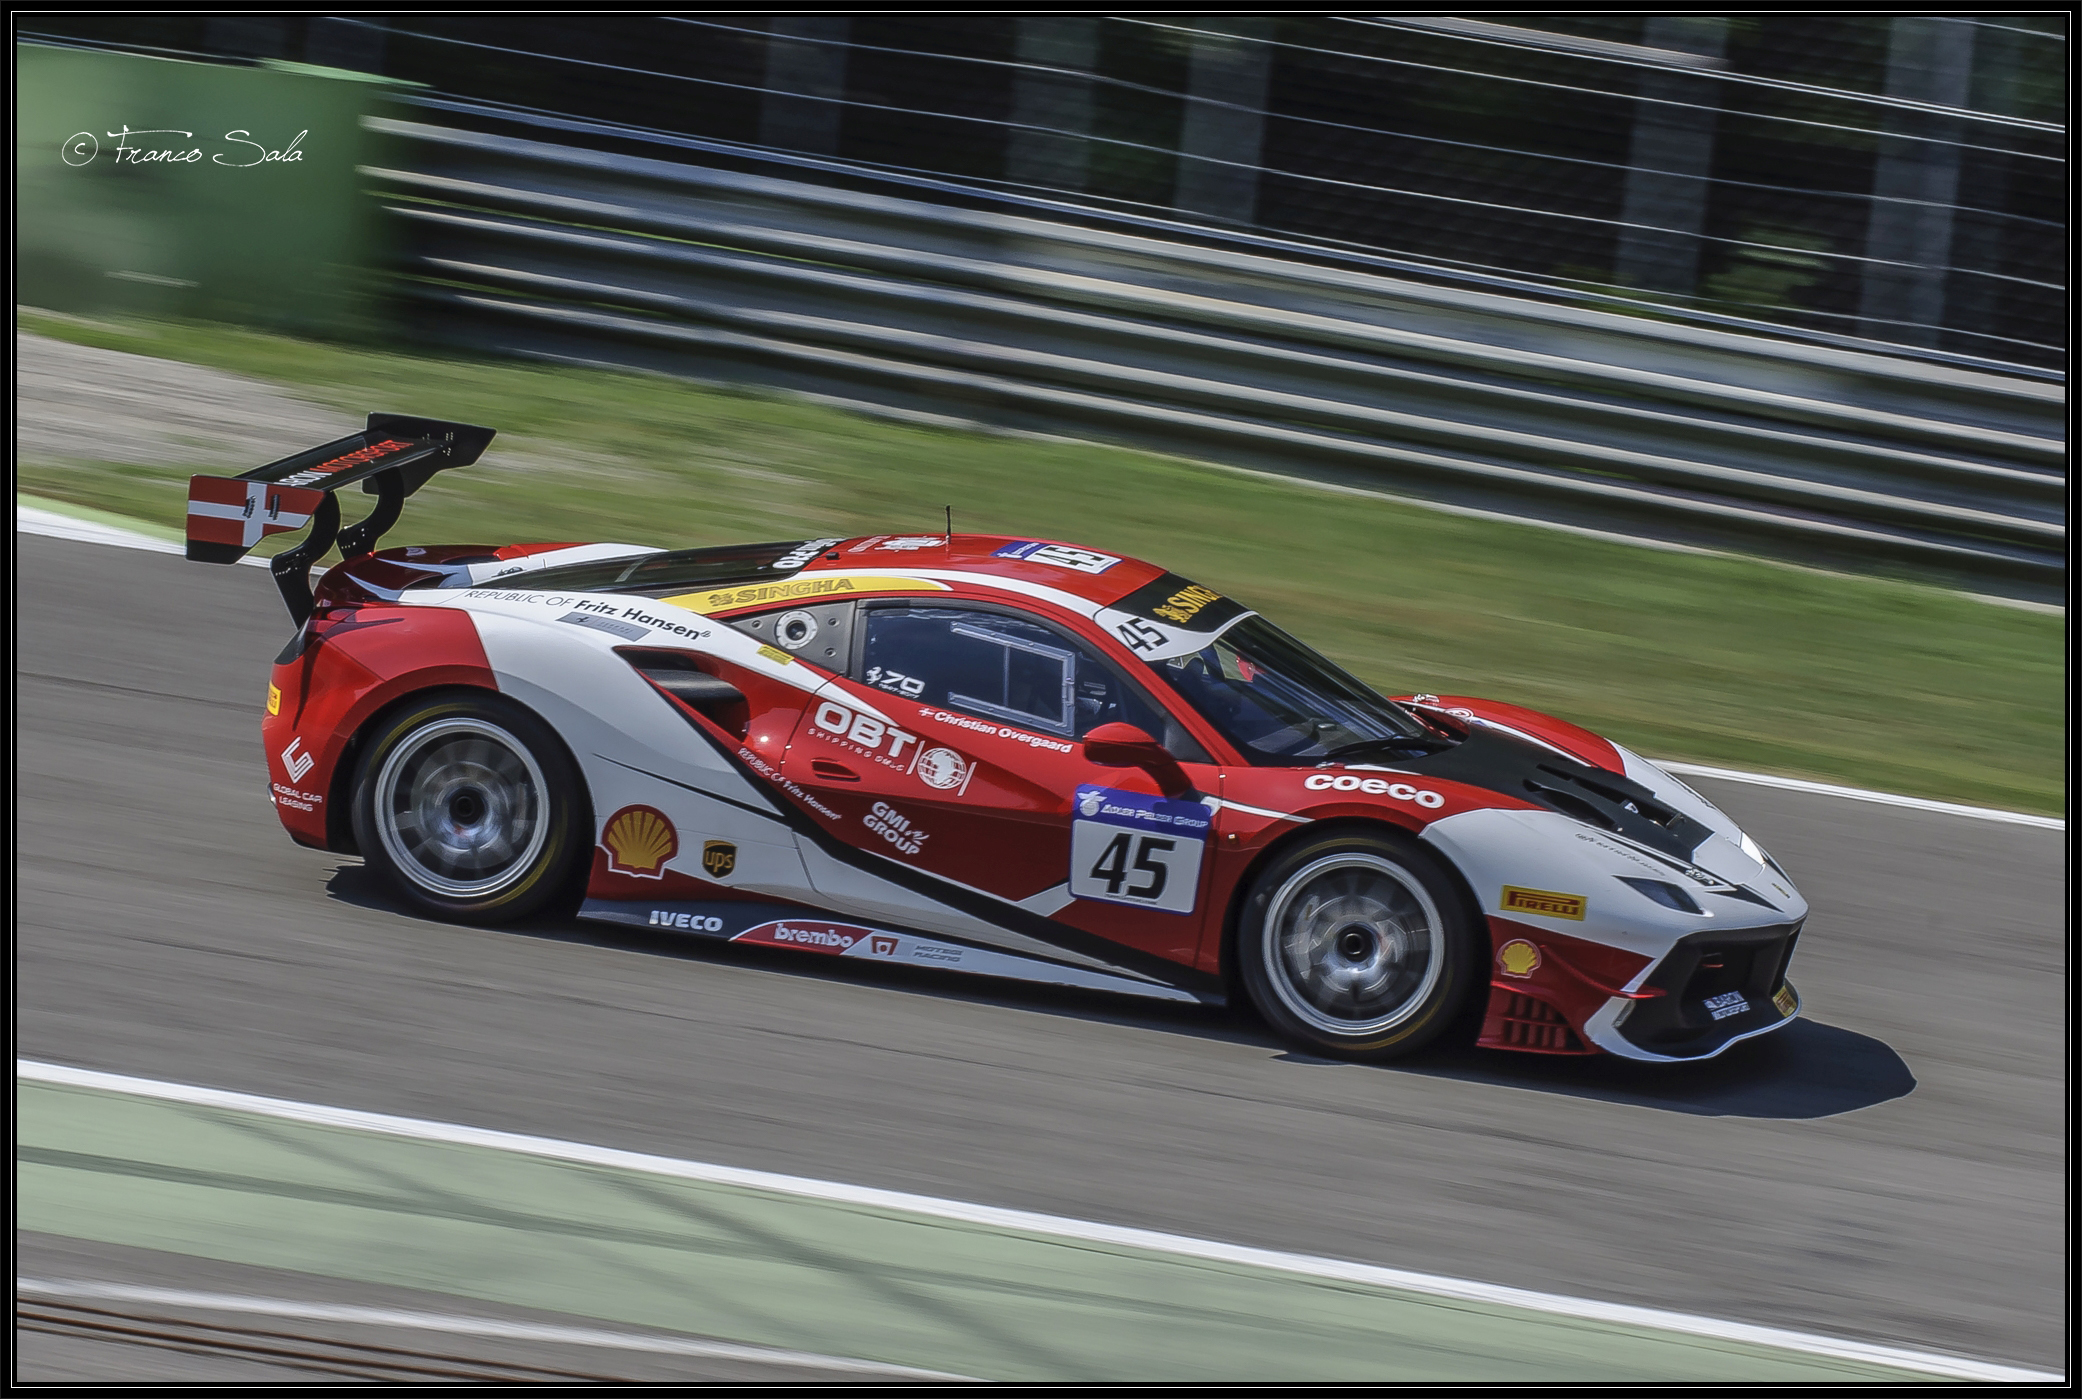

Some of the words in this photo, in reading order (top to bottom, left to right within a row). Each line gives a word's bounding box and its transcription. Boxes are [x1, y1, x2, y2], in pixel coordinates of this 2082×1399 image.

[1035, 546, 1106, 567] 45
[464, 590, 545, 605] REPUBLIC
[545, 597, 575, 608] OF
[573, 599, 617, 616] Fritz
[734, 578, 856, 603] SINGHA
[1115, 616, 1170, 652] 45
[880, 670, 925, 694] 70
[814, 701, 918, 758] OBT
[933, 711, 997, 736] Christian
[998, 727, 1073, 753] Overgaard
[808, 728, 873, 758] SHIPPING
[738, 747, 775, 776] REPUBLIC
[273, 783, 301, 799] GLOBAL
[302, 792, 323, 804] CAR
[278, 796, 314, 812] LEASING
[1304, 774, 1445, 809] coeco
[872, 801, 911, 832] GMI
[863, 814, 920, 855] GROUP
[705, 850, 734, 873] ups
[1088, 832, 1178, 900] 45
[1507, 891, 1580, 915] PIRELLI
[649, 910, 723, 932] IVECO
[774, 923, 854, 948] brembo
[913, 952, 962, 963] RACING
